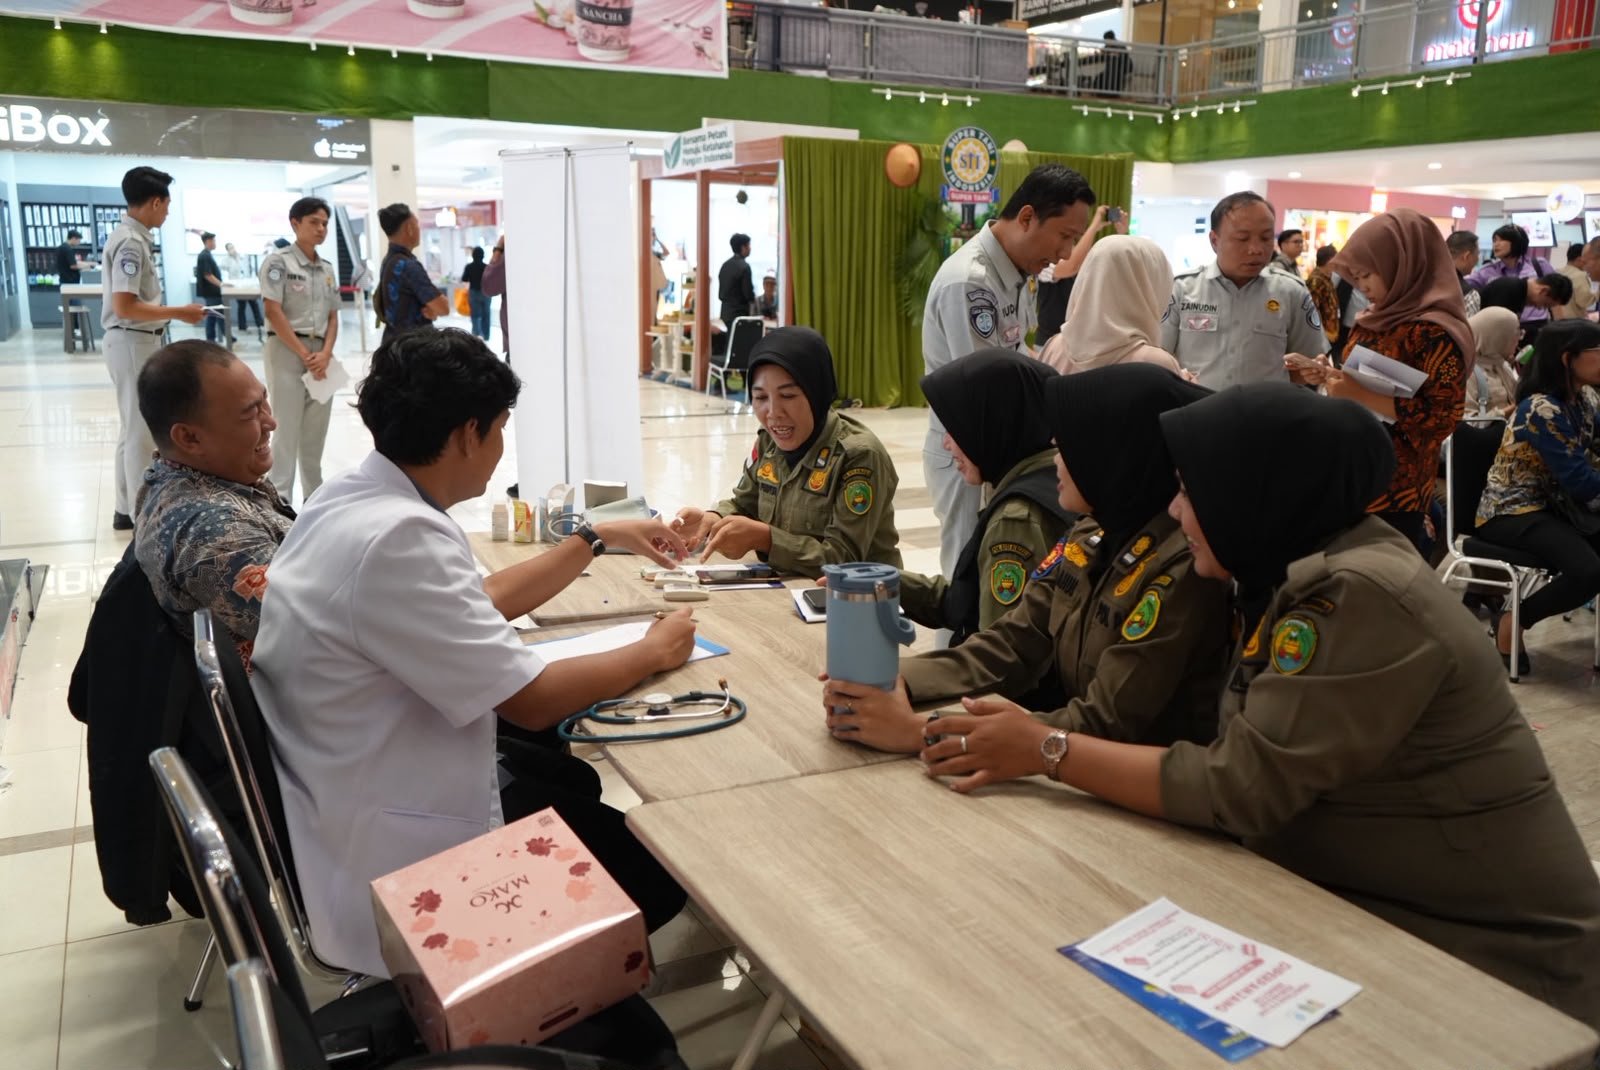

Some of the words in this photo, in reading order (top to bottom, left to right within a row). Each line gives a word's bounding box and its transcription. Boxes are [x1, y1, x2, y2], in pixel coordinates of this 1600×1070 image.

[583, 7, 623, 22] SANCHA
[0, 105, 113, 146] iBox
[708, 129, 727, 139] Petani
[948, 128, 976, 149] SUPER
[947, 170, 993, 192] INDONESIA
[1181, 302, 1217, 312] ZAINUDIN
[470, 875, 529, 907] MAKO
